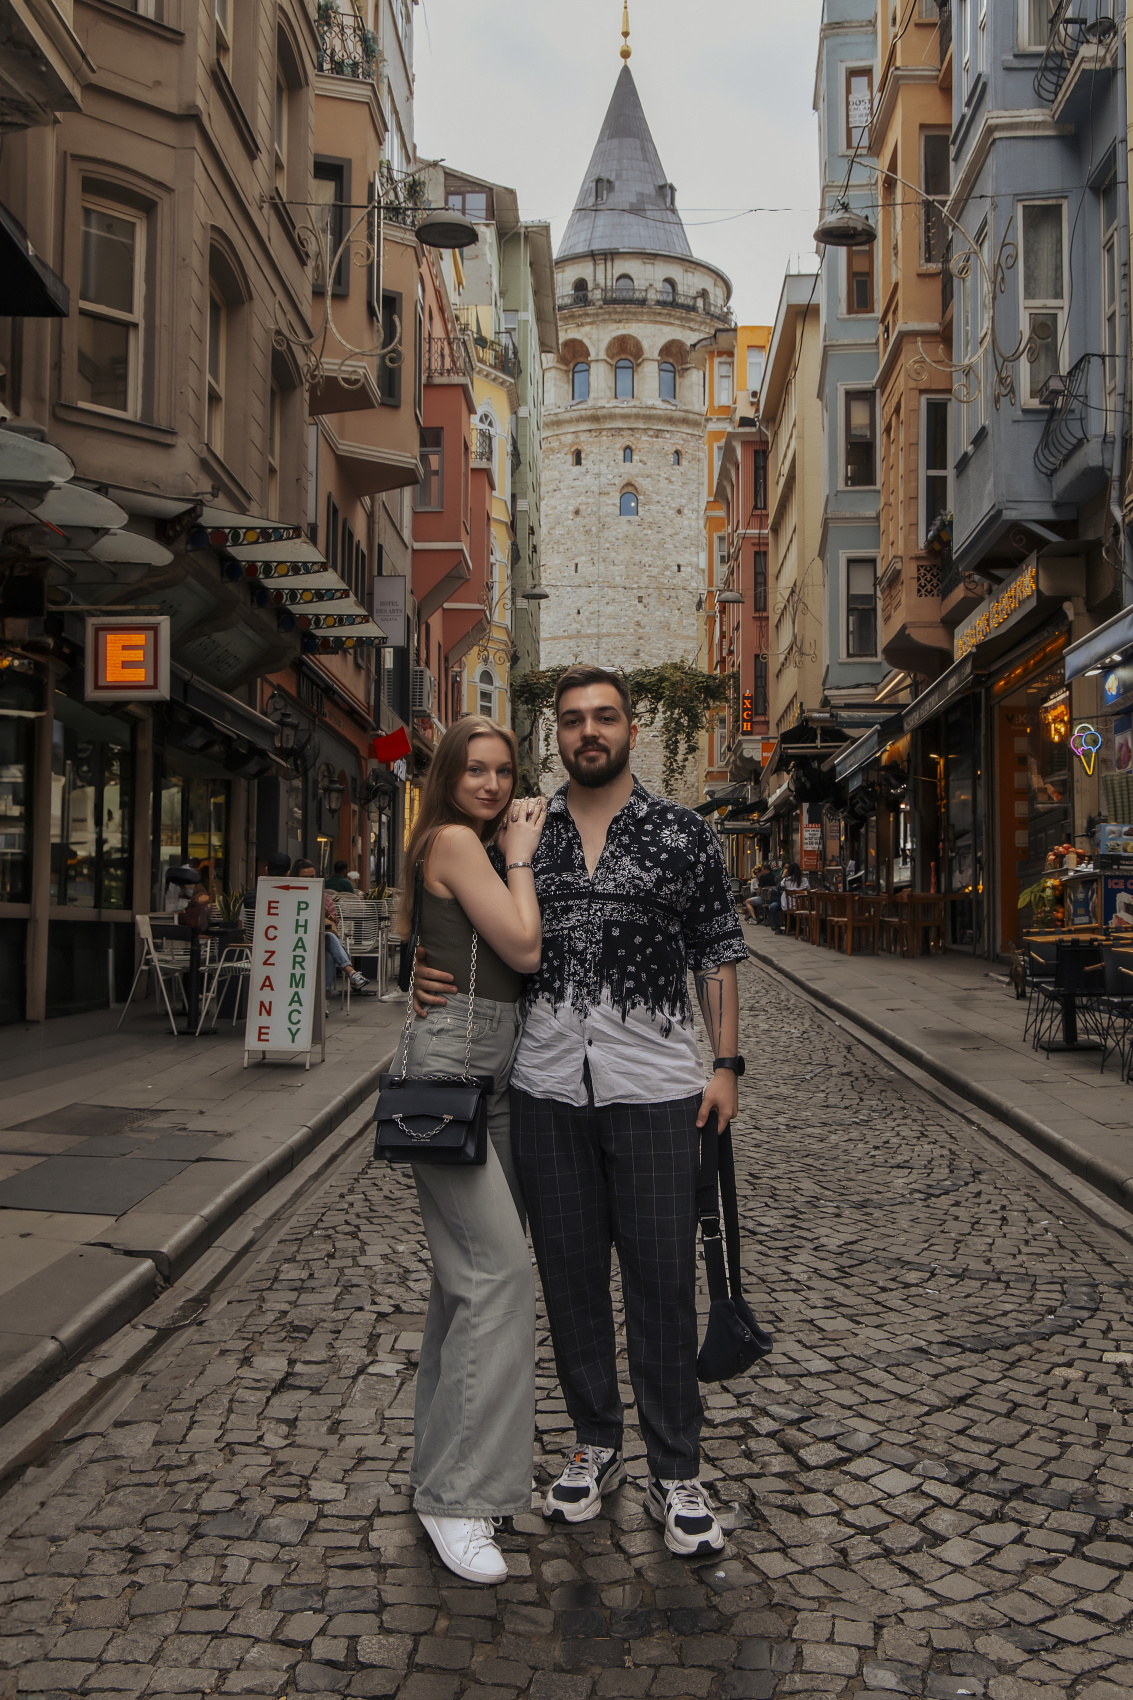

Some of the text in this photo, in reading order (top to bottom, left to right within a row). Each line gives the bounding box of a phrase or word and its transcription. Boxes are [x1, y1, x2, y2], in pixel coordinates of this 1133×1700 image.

[106, 634, 146, 682] E
[742, 691, 752, 731] XCH
[1108, 879, 1125, 889] ICE
[257, 900, 280, 1042] ECZANE
[287, 901, 309, 1043] PHARMACY
